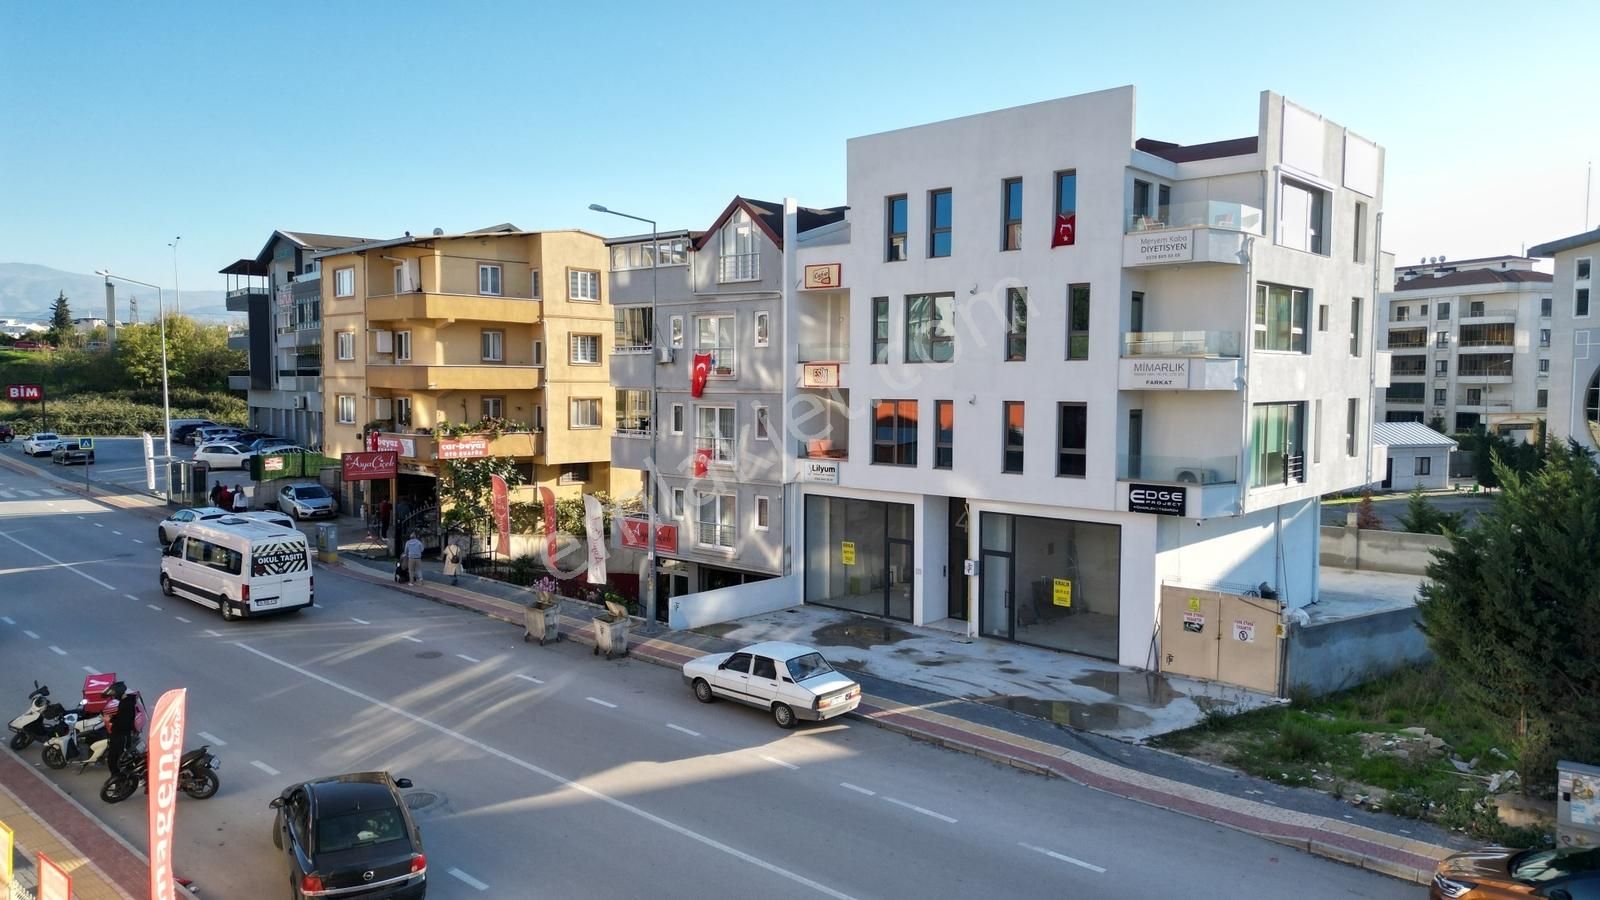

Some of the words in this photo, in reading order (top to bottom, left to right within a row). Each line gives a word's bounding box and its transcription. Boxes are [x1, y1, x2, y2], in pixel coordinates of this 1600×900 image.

[9, 386, 38, 398] BİM
[811, 464, 836, 473] Lilyum
[1130, 489, 1183, 504] EDGE
[258, 556, 279, 565] OKUL
[280, 553, 303, 562] TAŞITI
